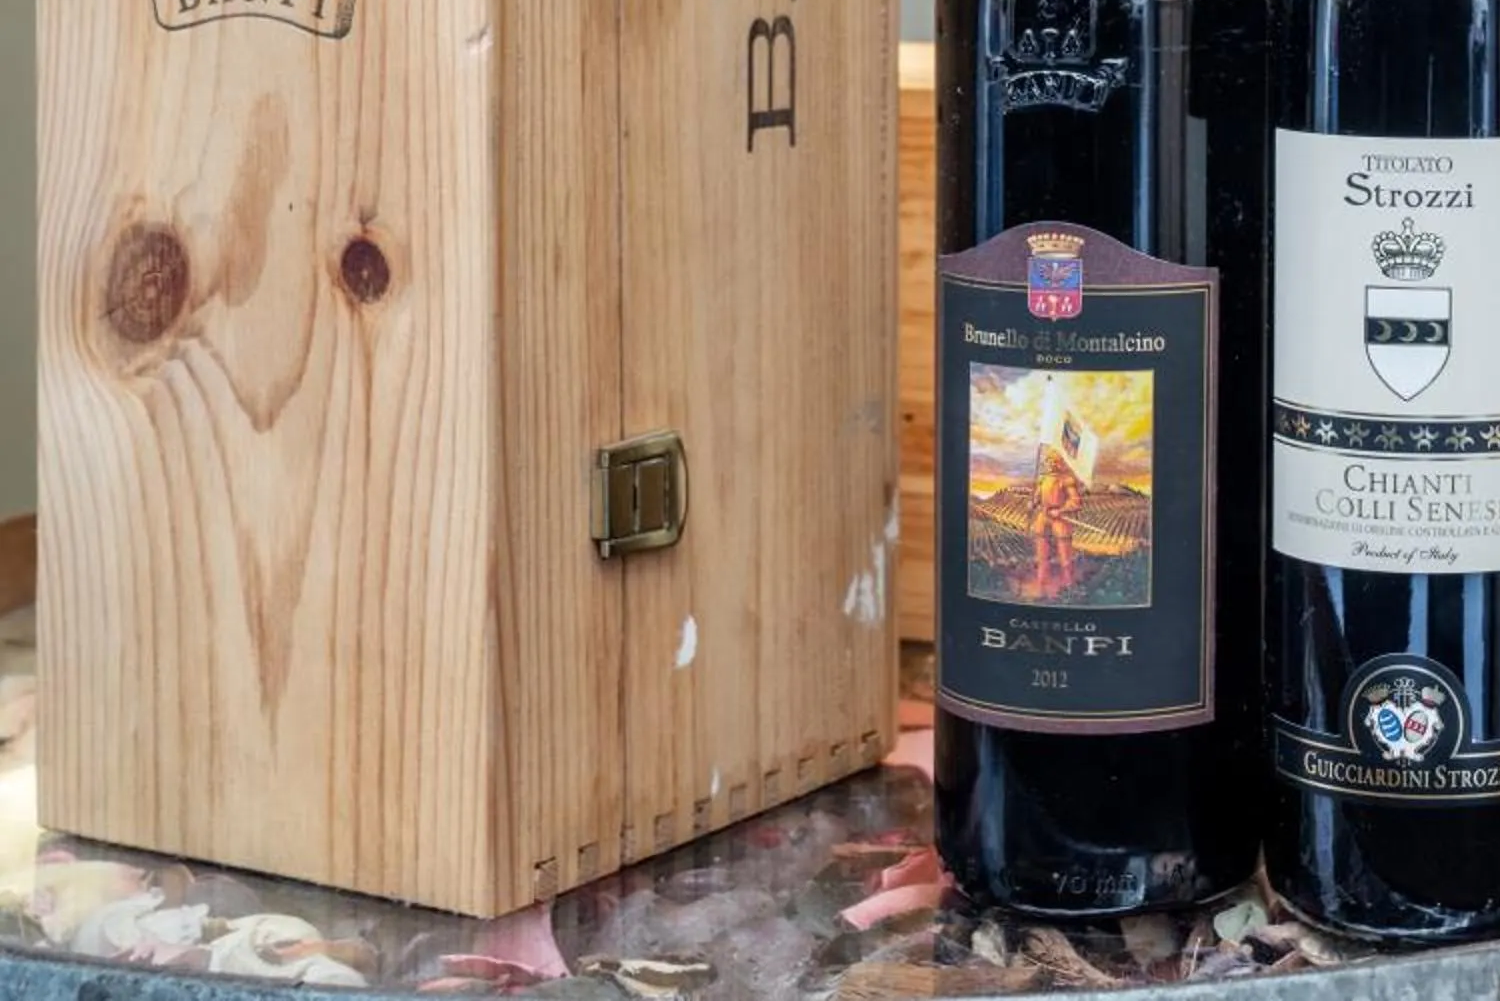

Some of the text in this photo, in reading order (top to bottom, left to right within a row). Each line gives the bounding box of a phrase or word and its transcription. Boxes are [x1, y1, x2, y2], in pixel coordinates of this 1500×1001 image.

[1361, 154, 1453, 174] TITOLATO
[1343, 172, 1474, 209] Strozzi
[963, 322, 1166, 352] Brunello di Montalcino
[1343, 464, 1473, 495] CHIANTI
[1316, 488, 1396, 521] COLLI
[1351, 540, 1402, 560] Product
[1402, 547, 1418, 565] of
[1009, 618, 1097, 632] CASTELLO
[980, 626, 1134, 656] BANFI
[1031, 669, 1069, 689] 2012
[1304, 752, 1431, 789] GUICCIARDINI
